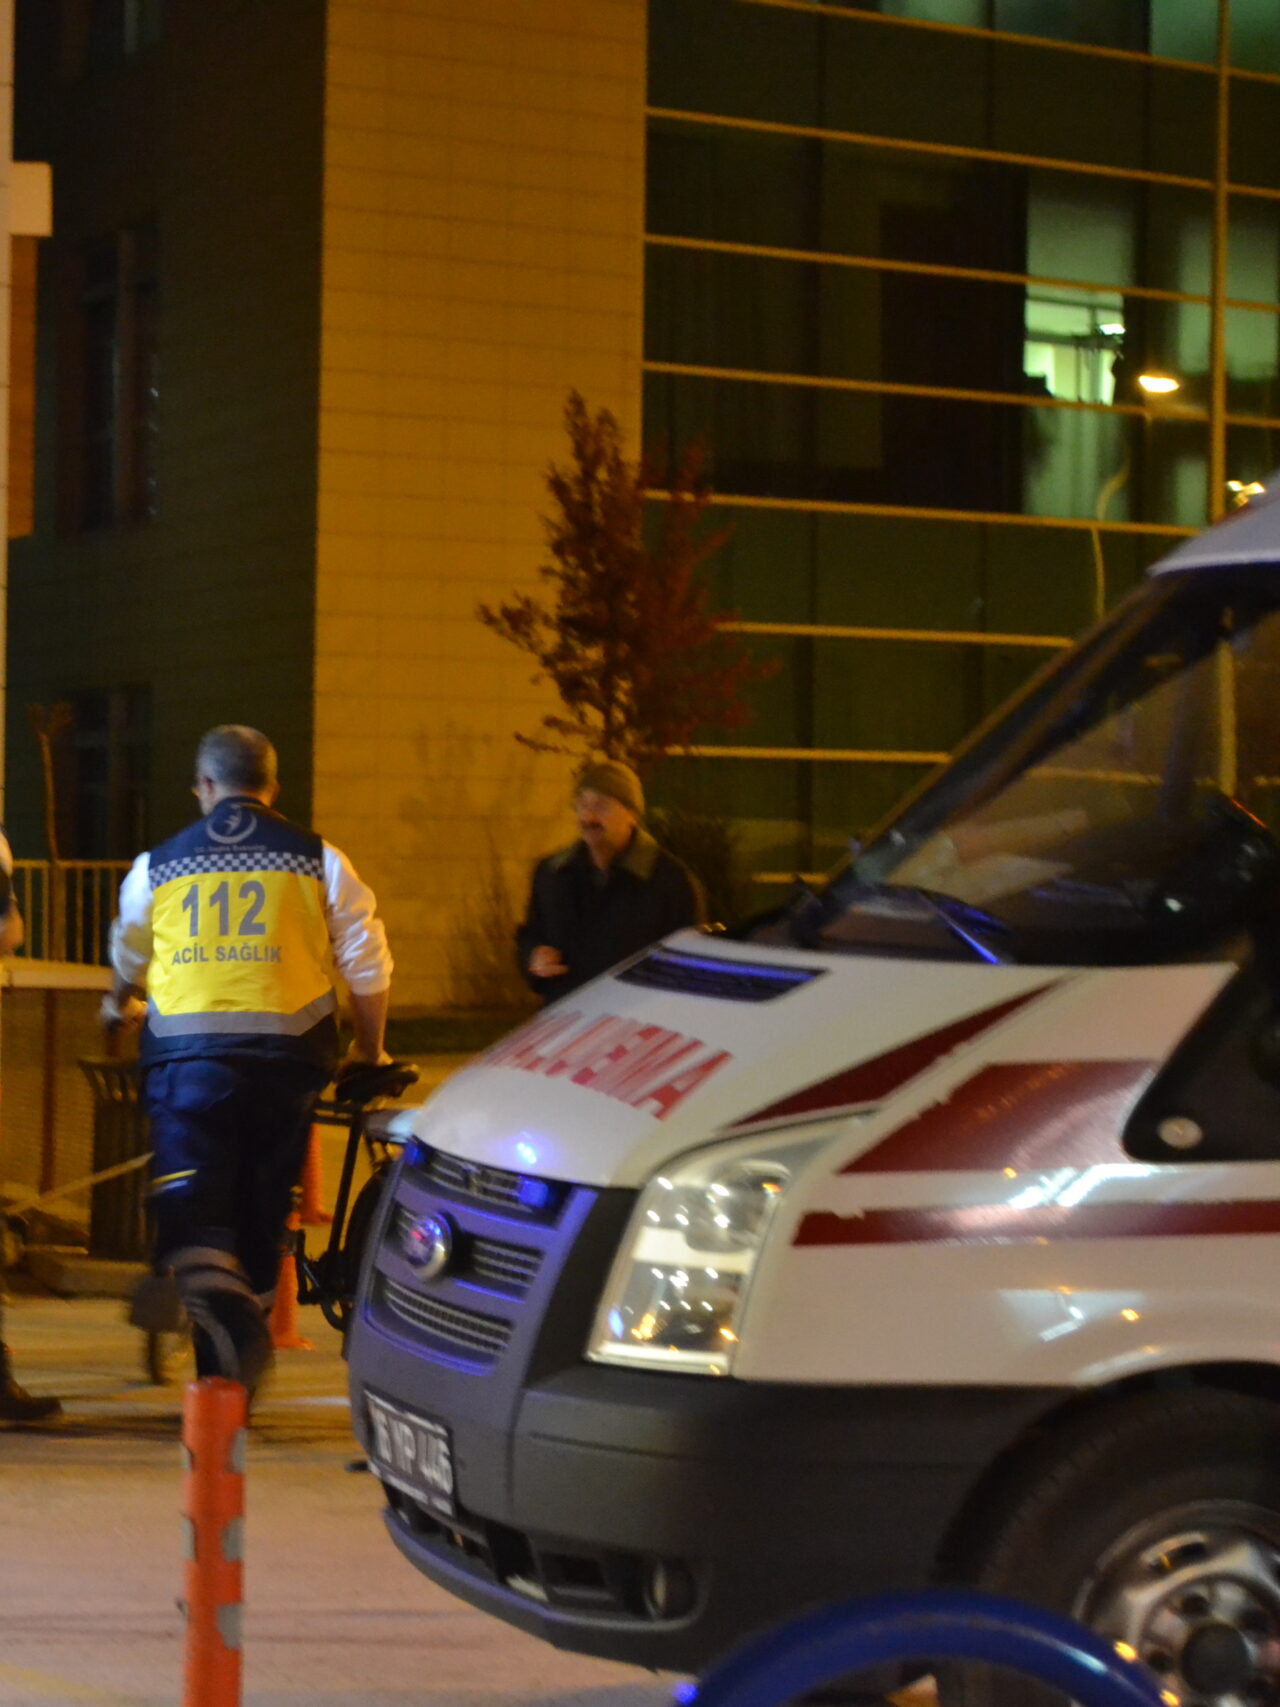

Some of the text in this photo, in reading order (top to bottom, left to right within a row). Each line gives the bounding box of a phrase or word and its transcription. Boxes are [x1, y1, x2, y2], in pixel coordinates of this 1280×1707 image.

[182, 880, 266, 937] 112
[172, 942, 282, 966] ACİL SAĞLIK
